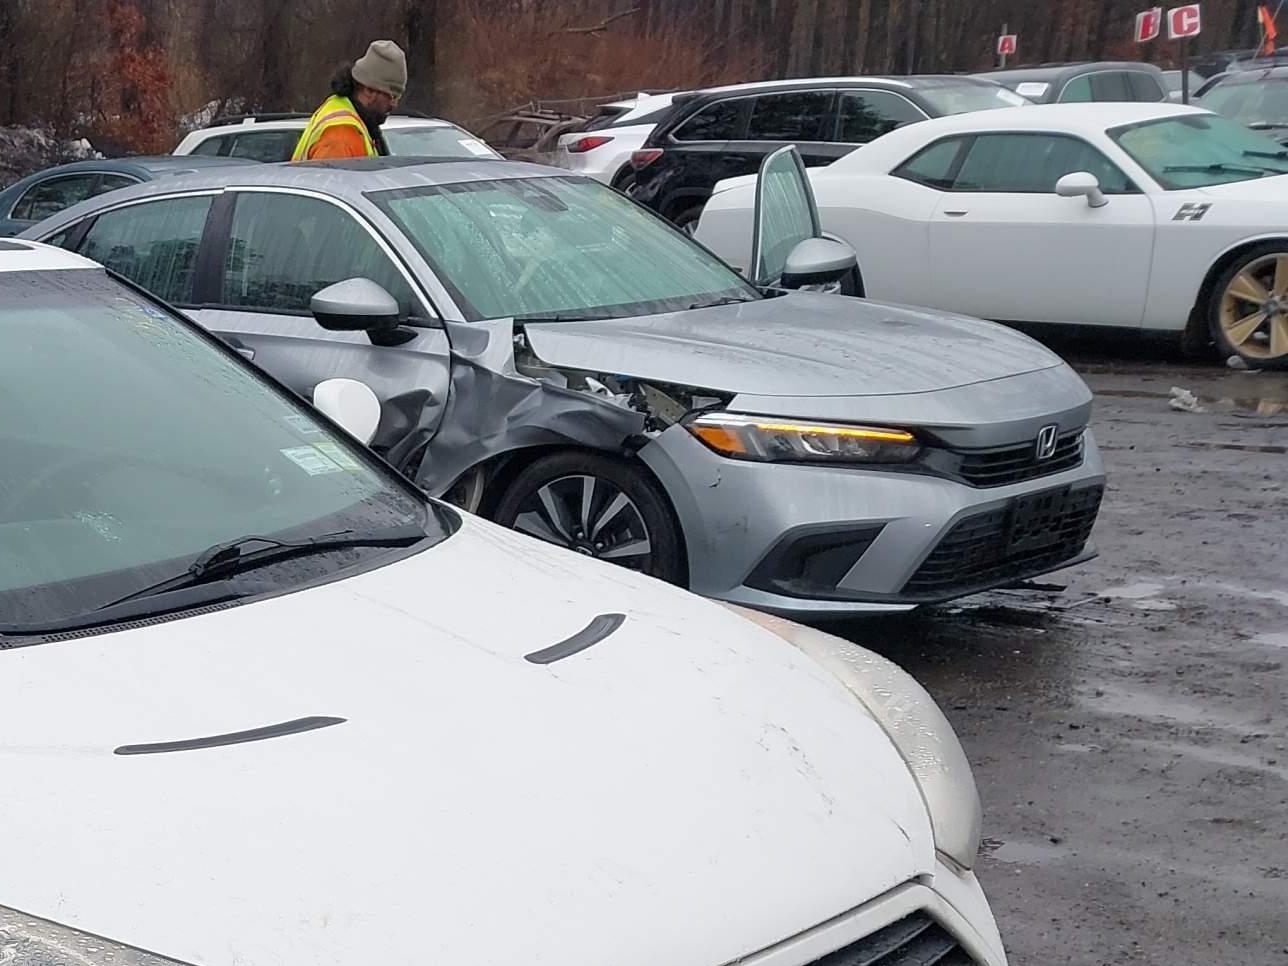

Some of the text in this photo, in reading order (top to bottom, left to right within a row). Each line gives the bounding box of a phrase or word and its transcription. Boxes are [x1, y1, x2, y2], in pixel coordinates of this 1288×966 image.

[1139, 12, 1159, 40] B
[1172, 7, 1199, 35] C
[1000, 37, 1014, 53] A
